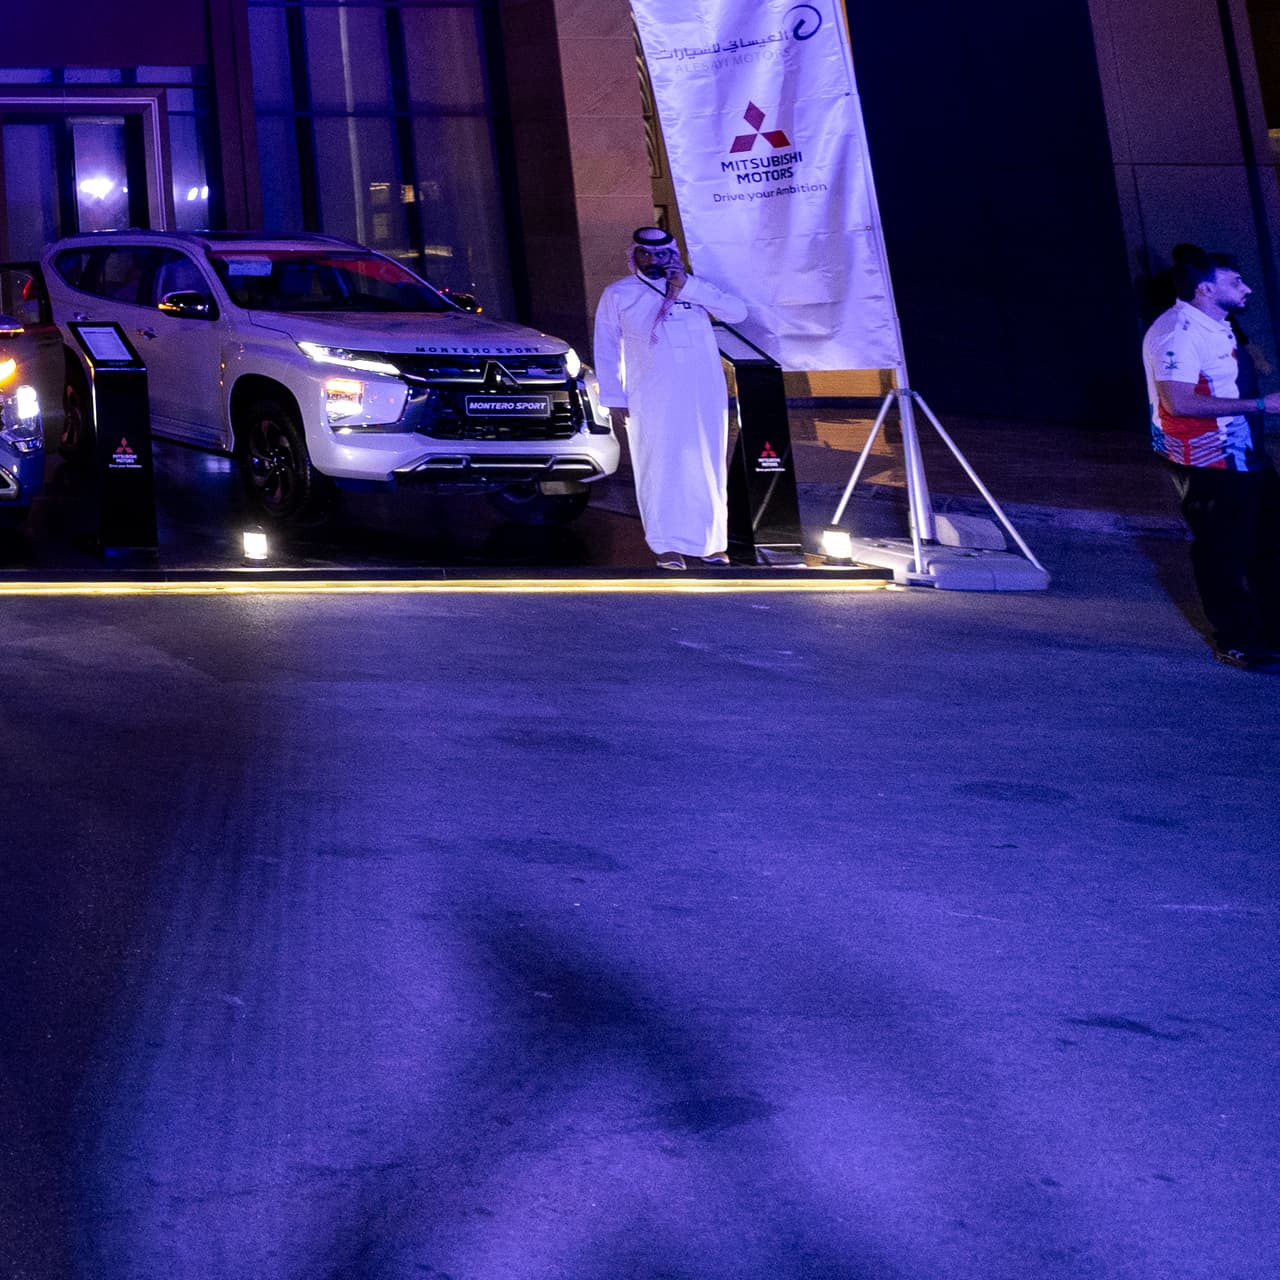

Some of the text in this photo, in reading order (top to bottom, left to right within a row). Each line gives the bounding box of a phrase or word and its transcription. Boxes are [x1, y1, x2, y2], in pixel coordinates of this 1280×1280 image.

[721, 151, 803, 172] MITSUBISHI
[736, 166, 794, 184] MOTORS
[713, 182, 828, 202] Drive your Ambition
[469, 402, 546, 410] MONTERO SPORT
